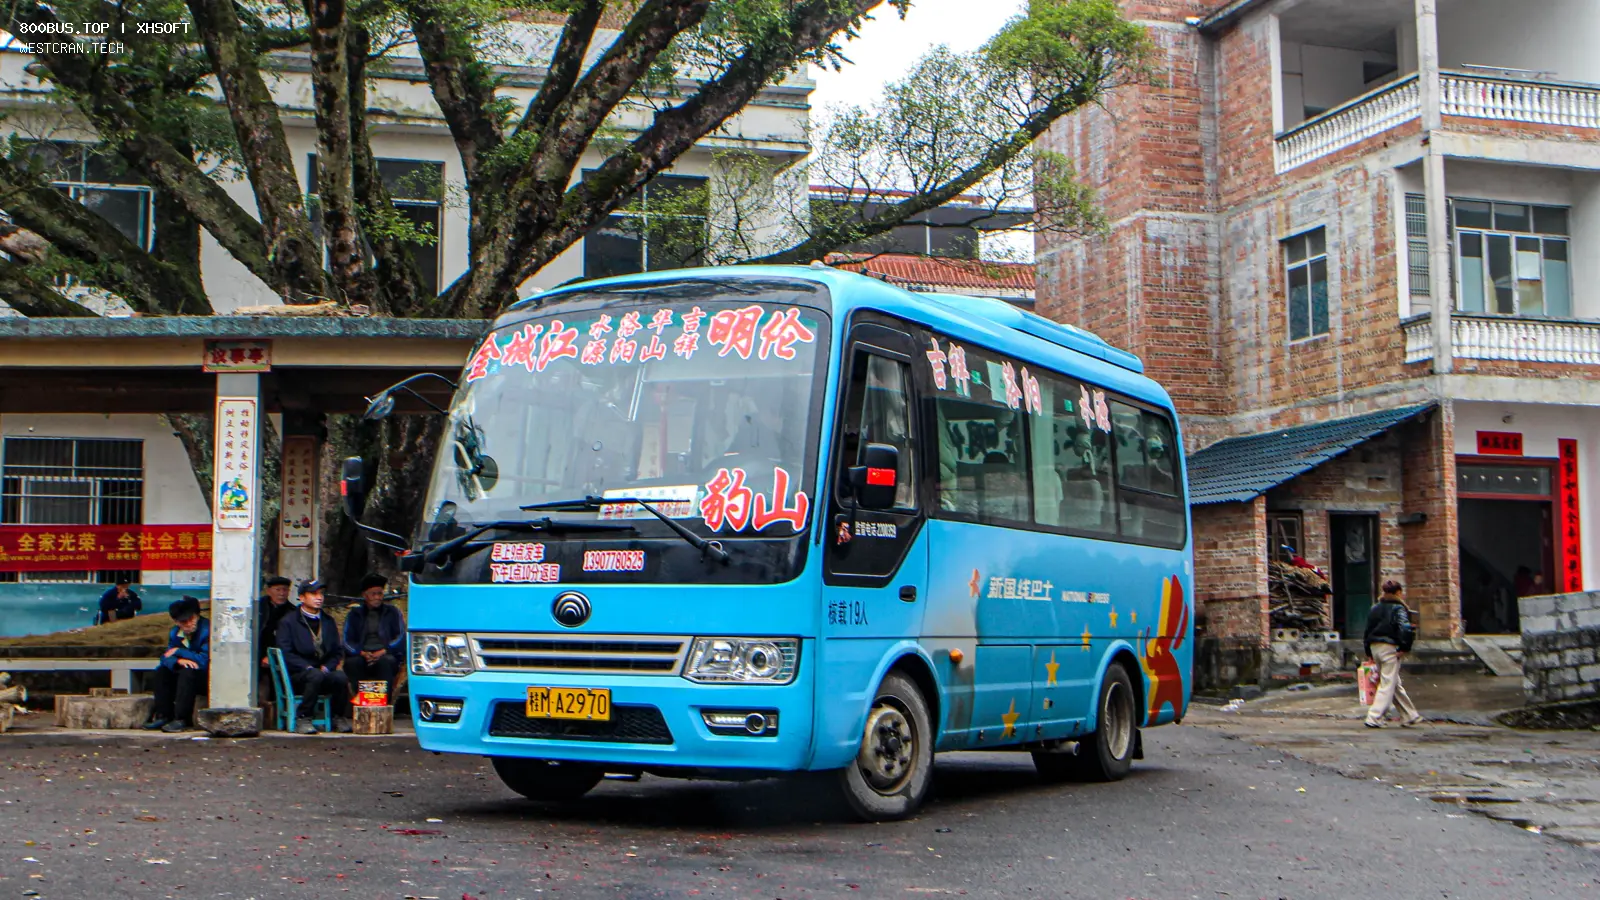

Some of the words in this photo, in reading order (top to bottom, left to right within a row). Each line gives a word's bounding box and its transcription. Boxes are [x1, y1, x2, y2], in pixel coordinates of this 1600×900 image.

[467, 320, 578, 382] 金城江
[707, 305, 814, 360] 明伦
[926, 337, 970, 396] 吉祥
[1002, 361, 1042, 416] 洛阳
[700, 467, 809, 532] 豹山
[489, 563, 560, 582] 下午1点10分返回
[491, 543, 545, 562] 早上9点发车
[583, 551, 645, 571] 13907780525
[987, 577, 1053, 601] 新国线巴士
[828, 600, 868, 625] 核载19人
